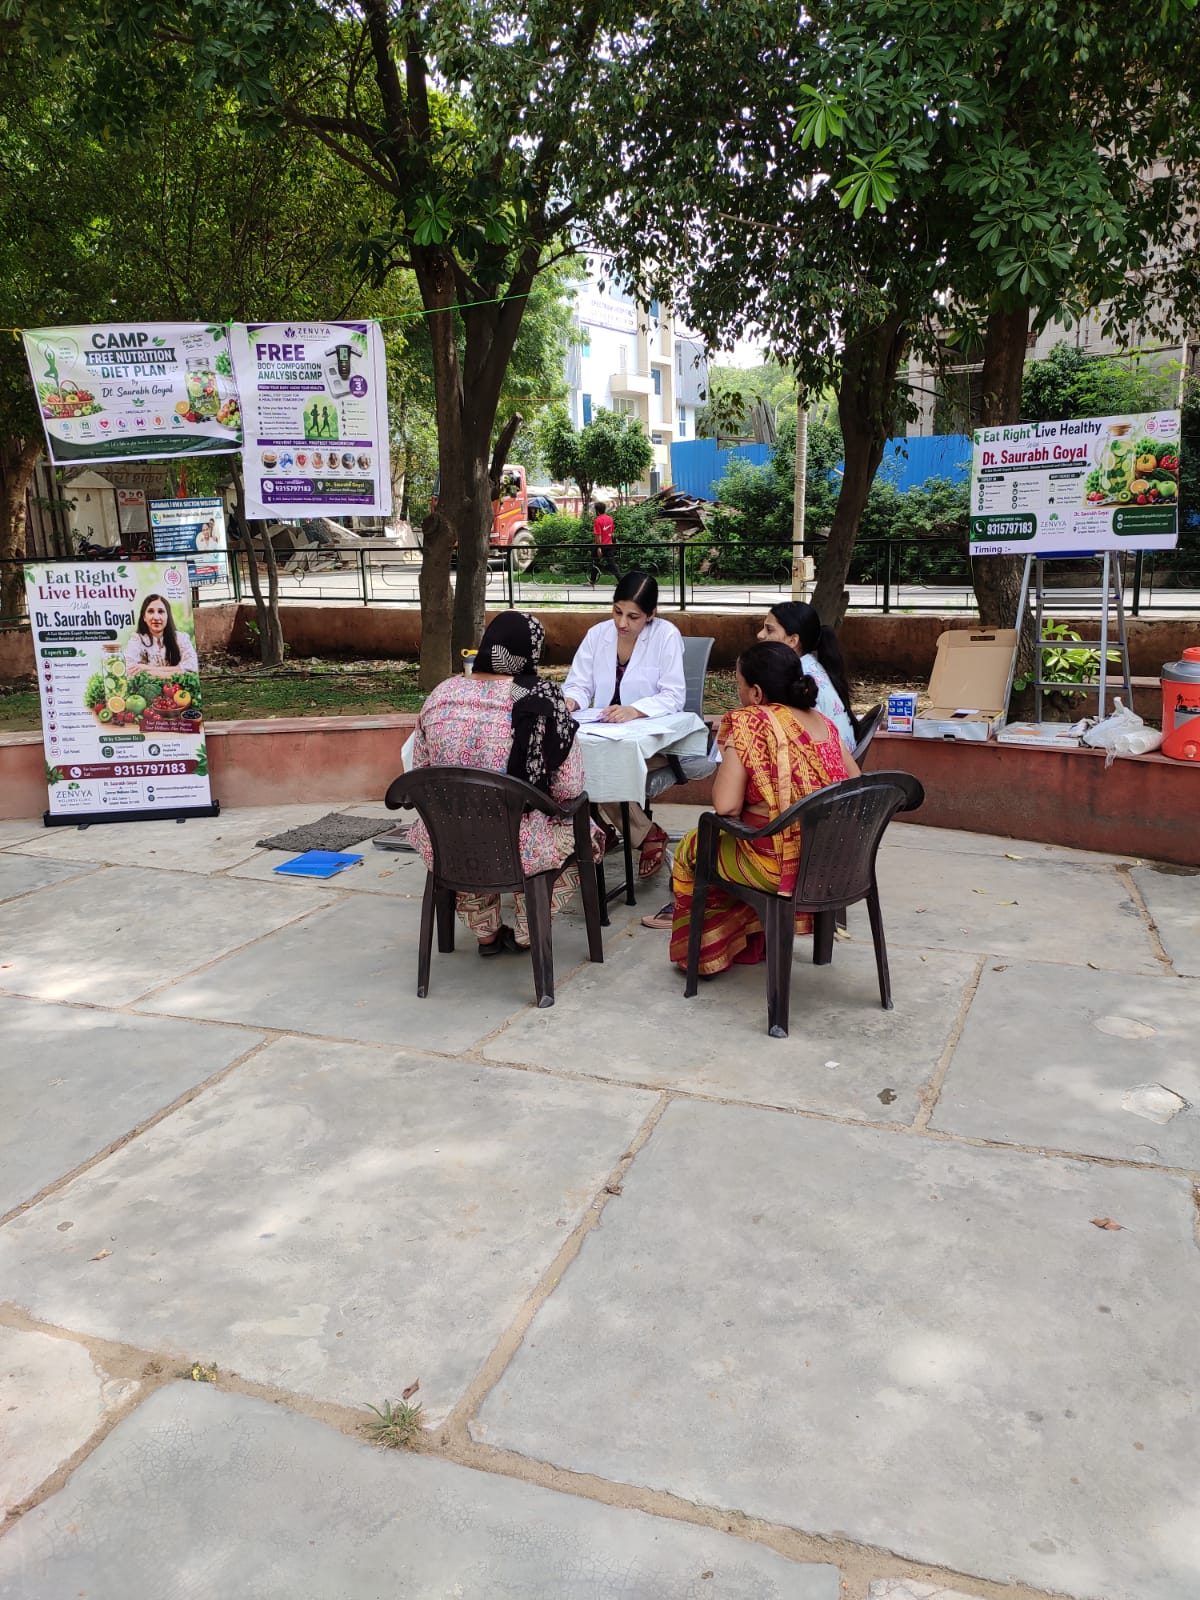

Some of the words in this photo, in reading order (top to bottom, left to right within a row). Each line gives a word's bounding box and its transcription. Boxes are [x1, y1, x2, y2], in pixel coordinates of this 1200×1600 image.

[92, 333, 148, 349] CAMP
[89, 351, 116, 364] FREE
[116, 349, 173, 364] NUTRITION
[256, 344, 305, 361] FREE
[102, 366, 129, 378] DIET
[134, 364, 166, 377] PLAN
[258, 371, 297, 380] ANALYSIS
[300, 371, 322, 380] CAMP
[118, 387, 149, 397] Saurabh
[152, 384, 173, 396] Goyal
[355, 382, 361, 391] 3
[984, 431, 1000, 442] Eat
[1003, 428, 1031, 442] Right
[1035, 426, 1056, 438] Live
[1060, 421, 1102, 436] Healthy
[983, 452, 998, 465] Dt.
[1001, 447, 1048, 465] Saurabh
[1053, 444, 1088, 463] Goyal
[987, 522, 1032, 535] 9315797183
[974, 546, 1002, 554] Timing
[46, 570, 70, 584] Eat
[75, 570, 116, 586] Right
[39, 586, 70, 600] Live
[76, 585, 137, 601] Healthy
[36, 612, 52, 627] Dt.
[54, 610, 101, 627] Saurabh
[105, 610, 135, 629] Goyal
[114, 763, 186, 775] 9315797183
[56, 790, 92, 798] ZENVYA
